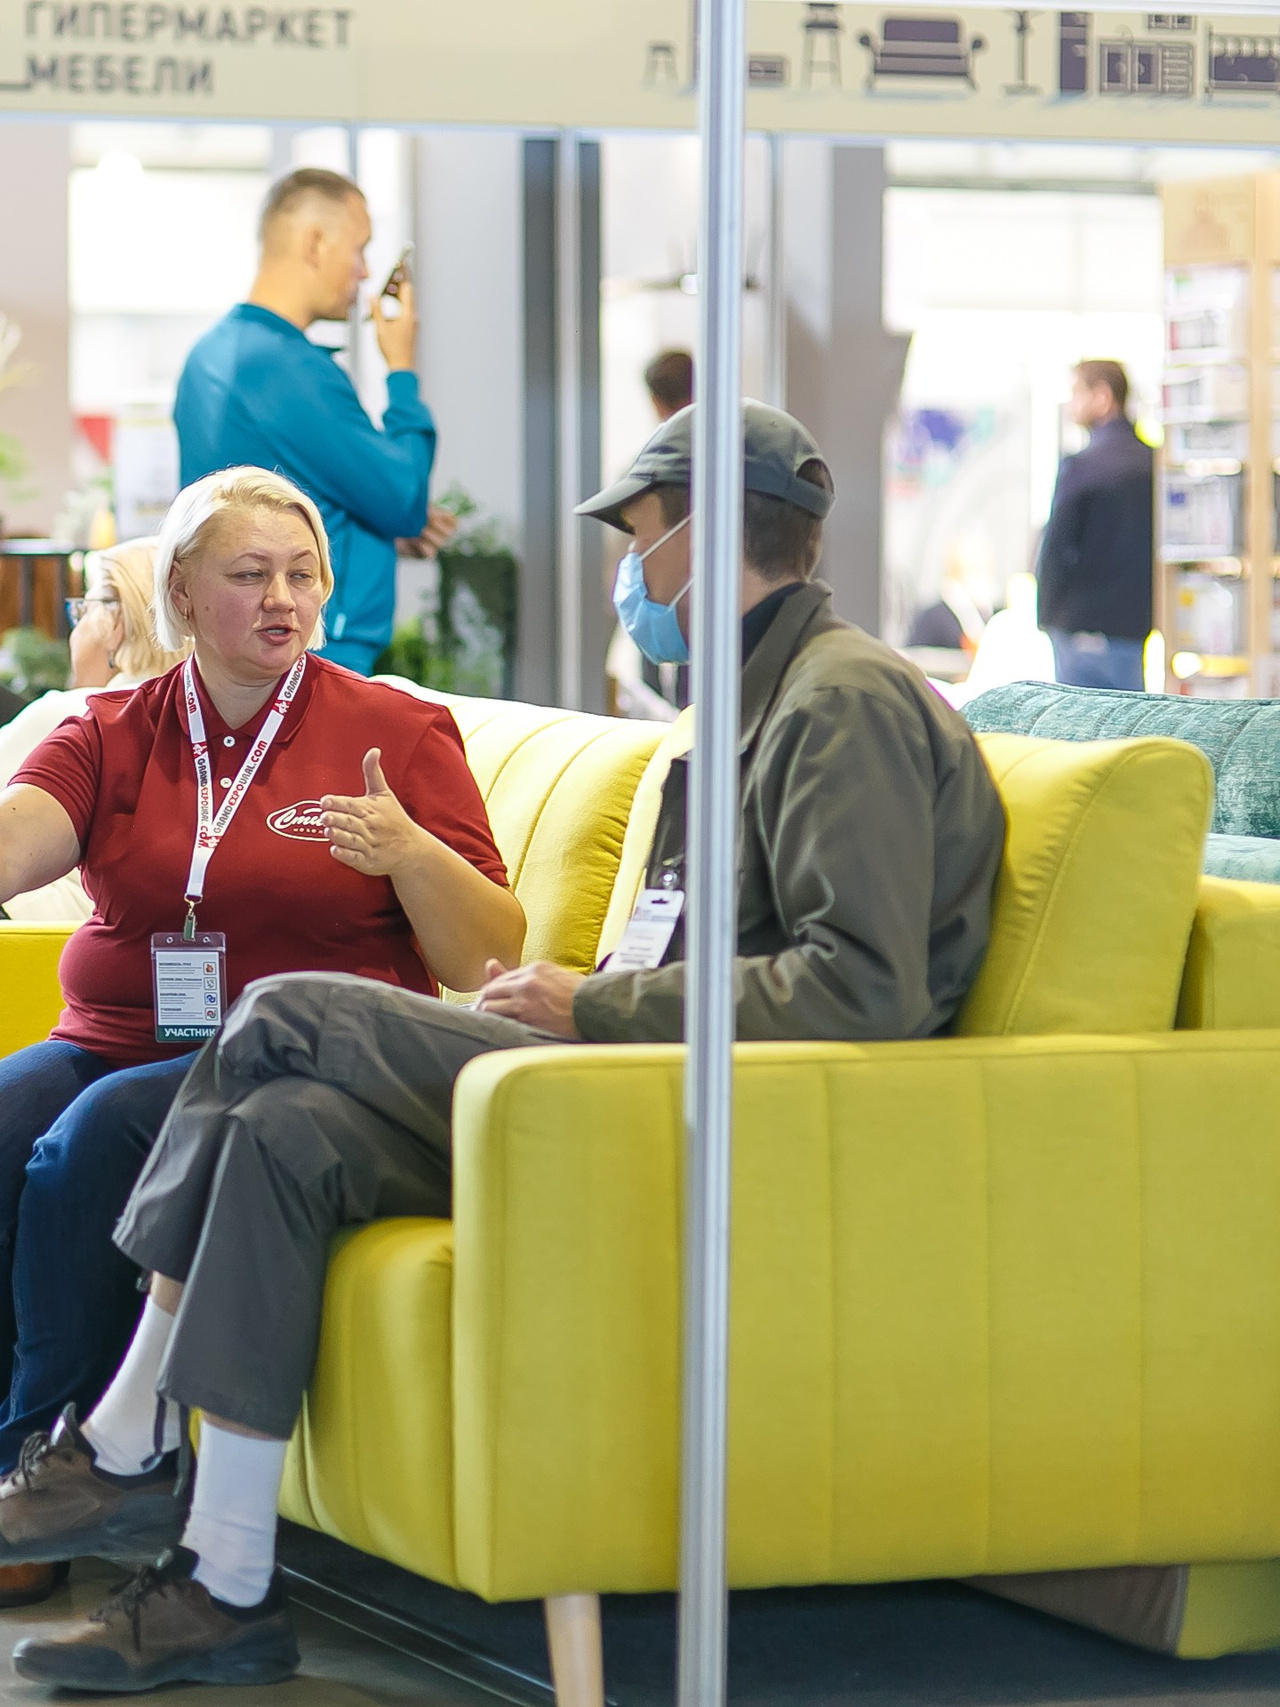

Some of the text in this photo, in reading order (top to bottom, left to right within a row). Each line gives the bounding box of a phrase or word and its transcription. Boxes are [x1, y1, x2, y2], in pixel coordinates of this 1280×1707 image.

[25, 2, 353, 48] ГИПЕРМАРКЕТ
[26, 54, 214, 95] МЕБЕЛИ
[213, 740, 268, 834] GRANDEXPOURAL.COM
[164, 1028, 216, 1037] УЧАСТНИК
